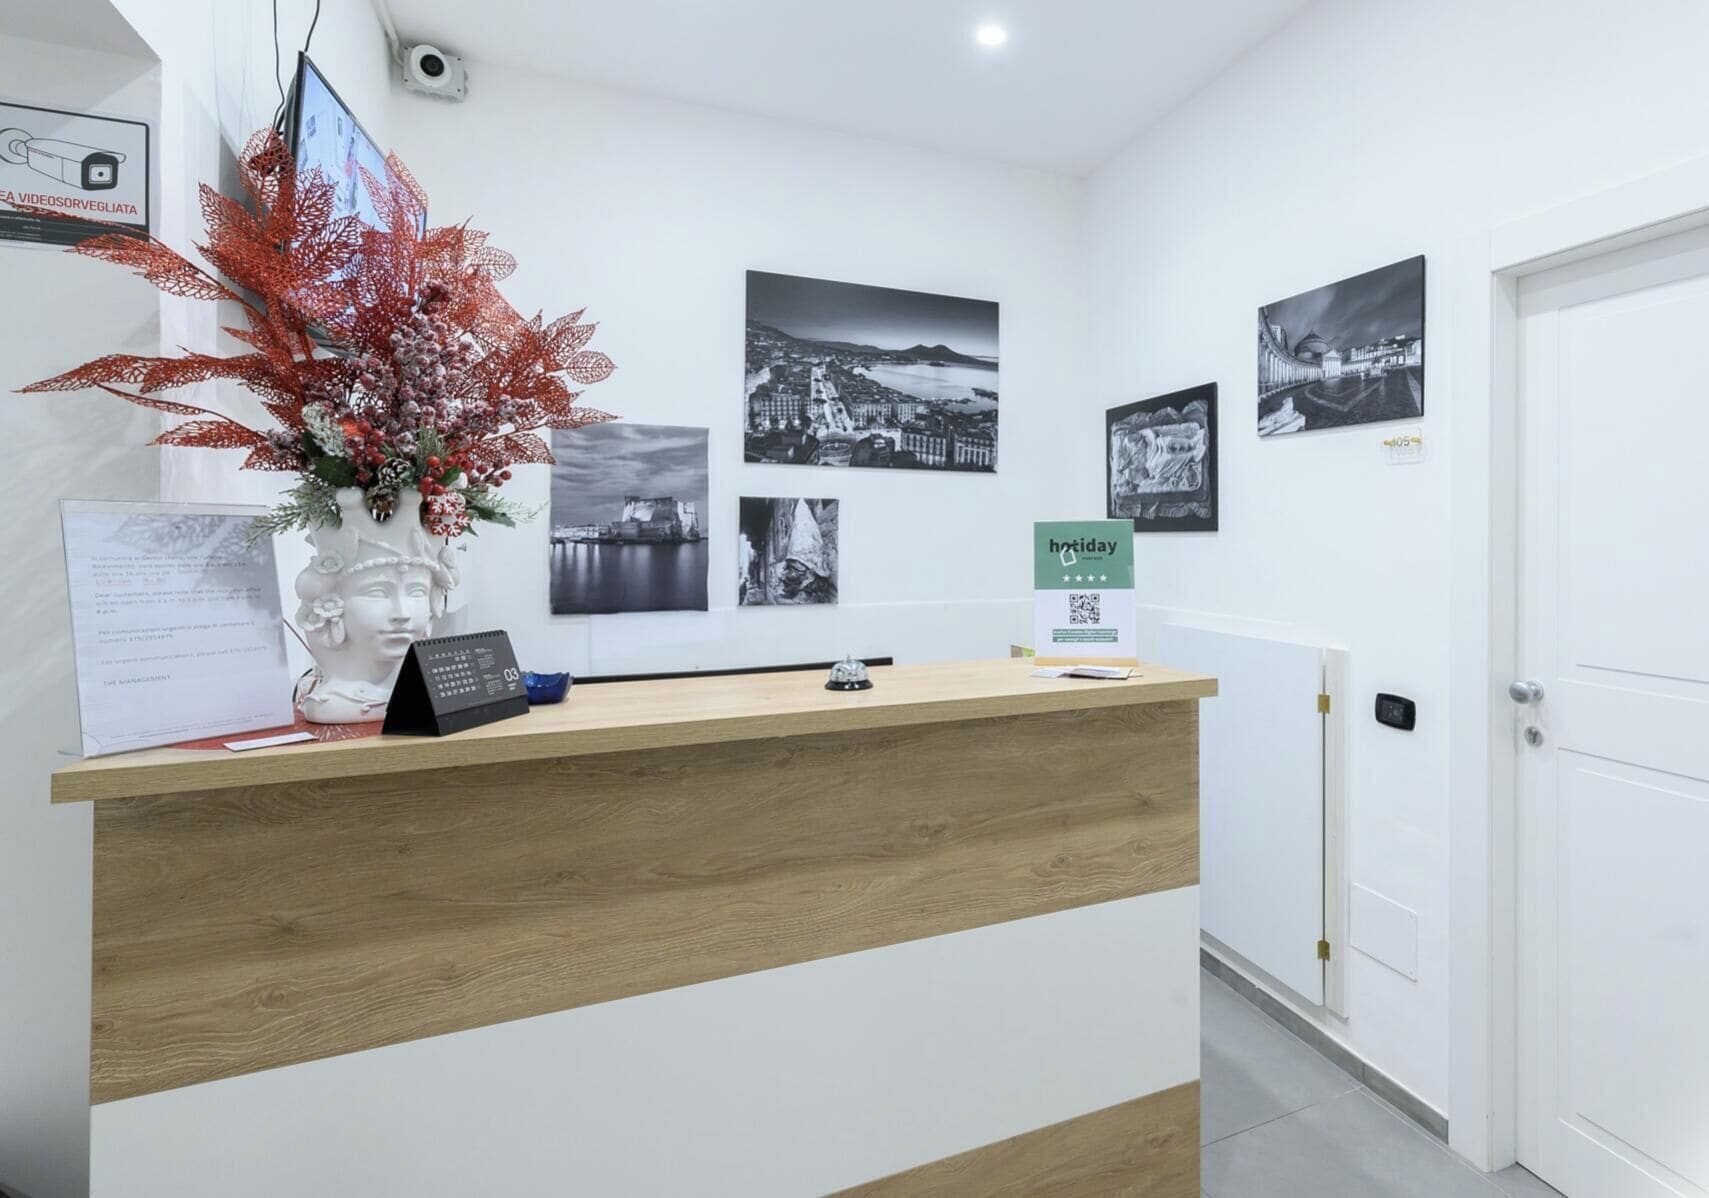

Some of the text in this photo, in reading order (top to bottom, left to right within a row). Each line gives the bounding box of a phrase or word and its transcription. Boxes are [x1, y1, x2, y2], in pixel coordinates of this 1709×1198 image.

[18, 192, 138, 215] VIDEOSORVEGLIATA
[1049, 537, 1118, 556] hotiday
[504, 667, 519, 681] 03
